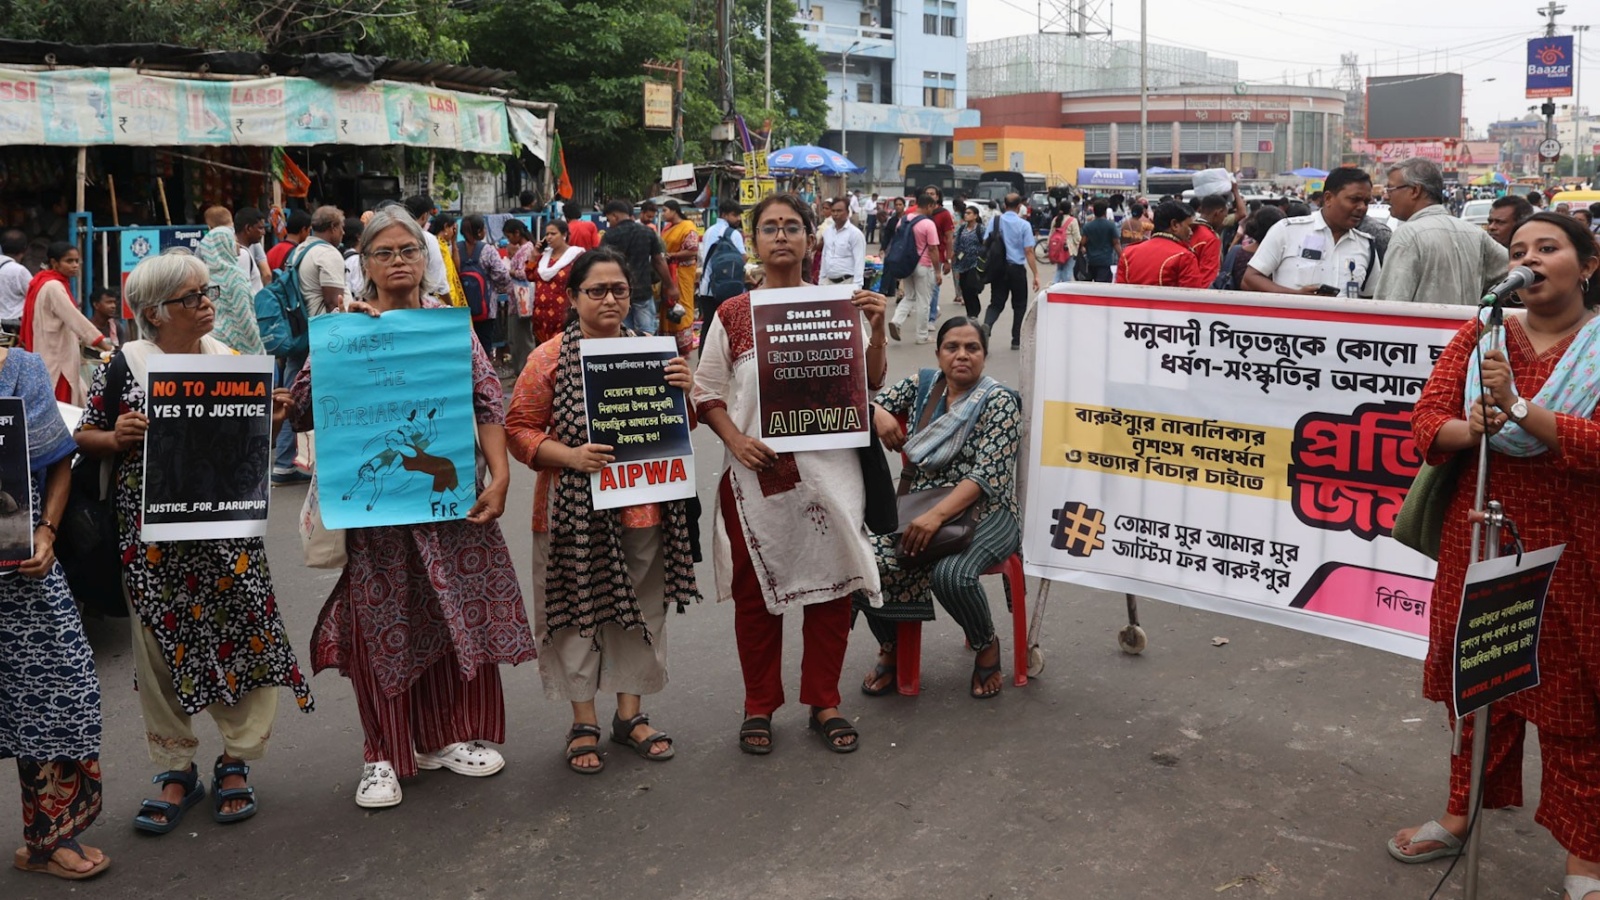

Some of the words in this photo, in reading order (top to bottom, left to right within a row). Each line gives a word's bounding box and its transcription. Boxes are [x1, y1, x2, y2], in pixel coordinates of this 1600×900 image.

[1528, 64, 1570, 75] Baazar
[231, 87, 283, 106] LASSI
[1092, 170, 1124, 179] Amul
[175, 230, 201, 240] Speed
[190, 238, 201, 248] B
[766, 320, 854, 332] BRAHMINICAL
[769, 331, 852, 344] PATRIARCHY
[1124, 319, 1201, 349] মনুবাদী
[1209, 320, 1327, 359] পিতৃতন্ত্রকে
[1336, 338, 1418, 367] কোনো
[768, 350, 803, 364] END
[806, 348, 854, 362] RAPE
[368, 367, 406, 386] THE
[774, 364, 850, 380] CULTURE
[1161, 350, 1321, 394] ধর্ষণ-সংস্কৃতির
[152, 381, 176, 397] NO
[182, 381, 205, 396] TO
[210, 381, 266, 397] JUMLA
[658, 385, 666, 394] ও
[153, 404, 180, 418] YES
[186, 404, 204, 418] TO
[208, 404, 266, 418] JUSTICE
[319, 396, 448, 430] PATRIARCHY
[598, 402, 630, 414] নিরাপত্তার
[631, 400, 648, 411] উপর
[650, 397, 674, 412] মনুবাদী
[628, 416, 659, 428] আঘাতের
[768, 406, 862, 435] AIPWA
[1161, 420, 1266, 446] নাবালিকার
[1132, 437, 1185, 459] নৃশংস
[600, 458, 687, 491] AIPWA
[1066, 450, 1082, 463] ও
[1088, 452, 1140, 474] হত্যার
[1145, 456, 1199, 482] বিচার
[1205, 468, 1265, 490] চাইতে
[146, 500, 266, 514] JUSTICE_FOR_BARUIPUR
[431, 501, 459, 518] FIR
[1114, 514, 1171, 538] তোমার
[1174, 524, 1202, 550] সুর
[1206, 530, 1265, 556] আমার
[1269, 541, 1300, 568] সুর
[1111, 536, 1172, 565] জাস্টিস
[1176, 551, 1208, 572] ফর
[1212, 558, 1292, 594] বারুইপুর
[1375, 586, 1427, 618] বিভিন্ন
